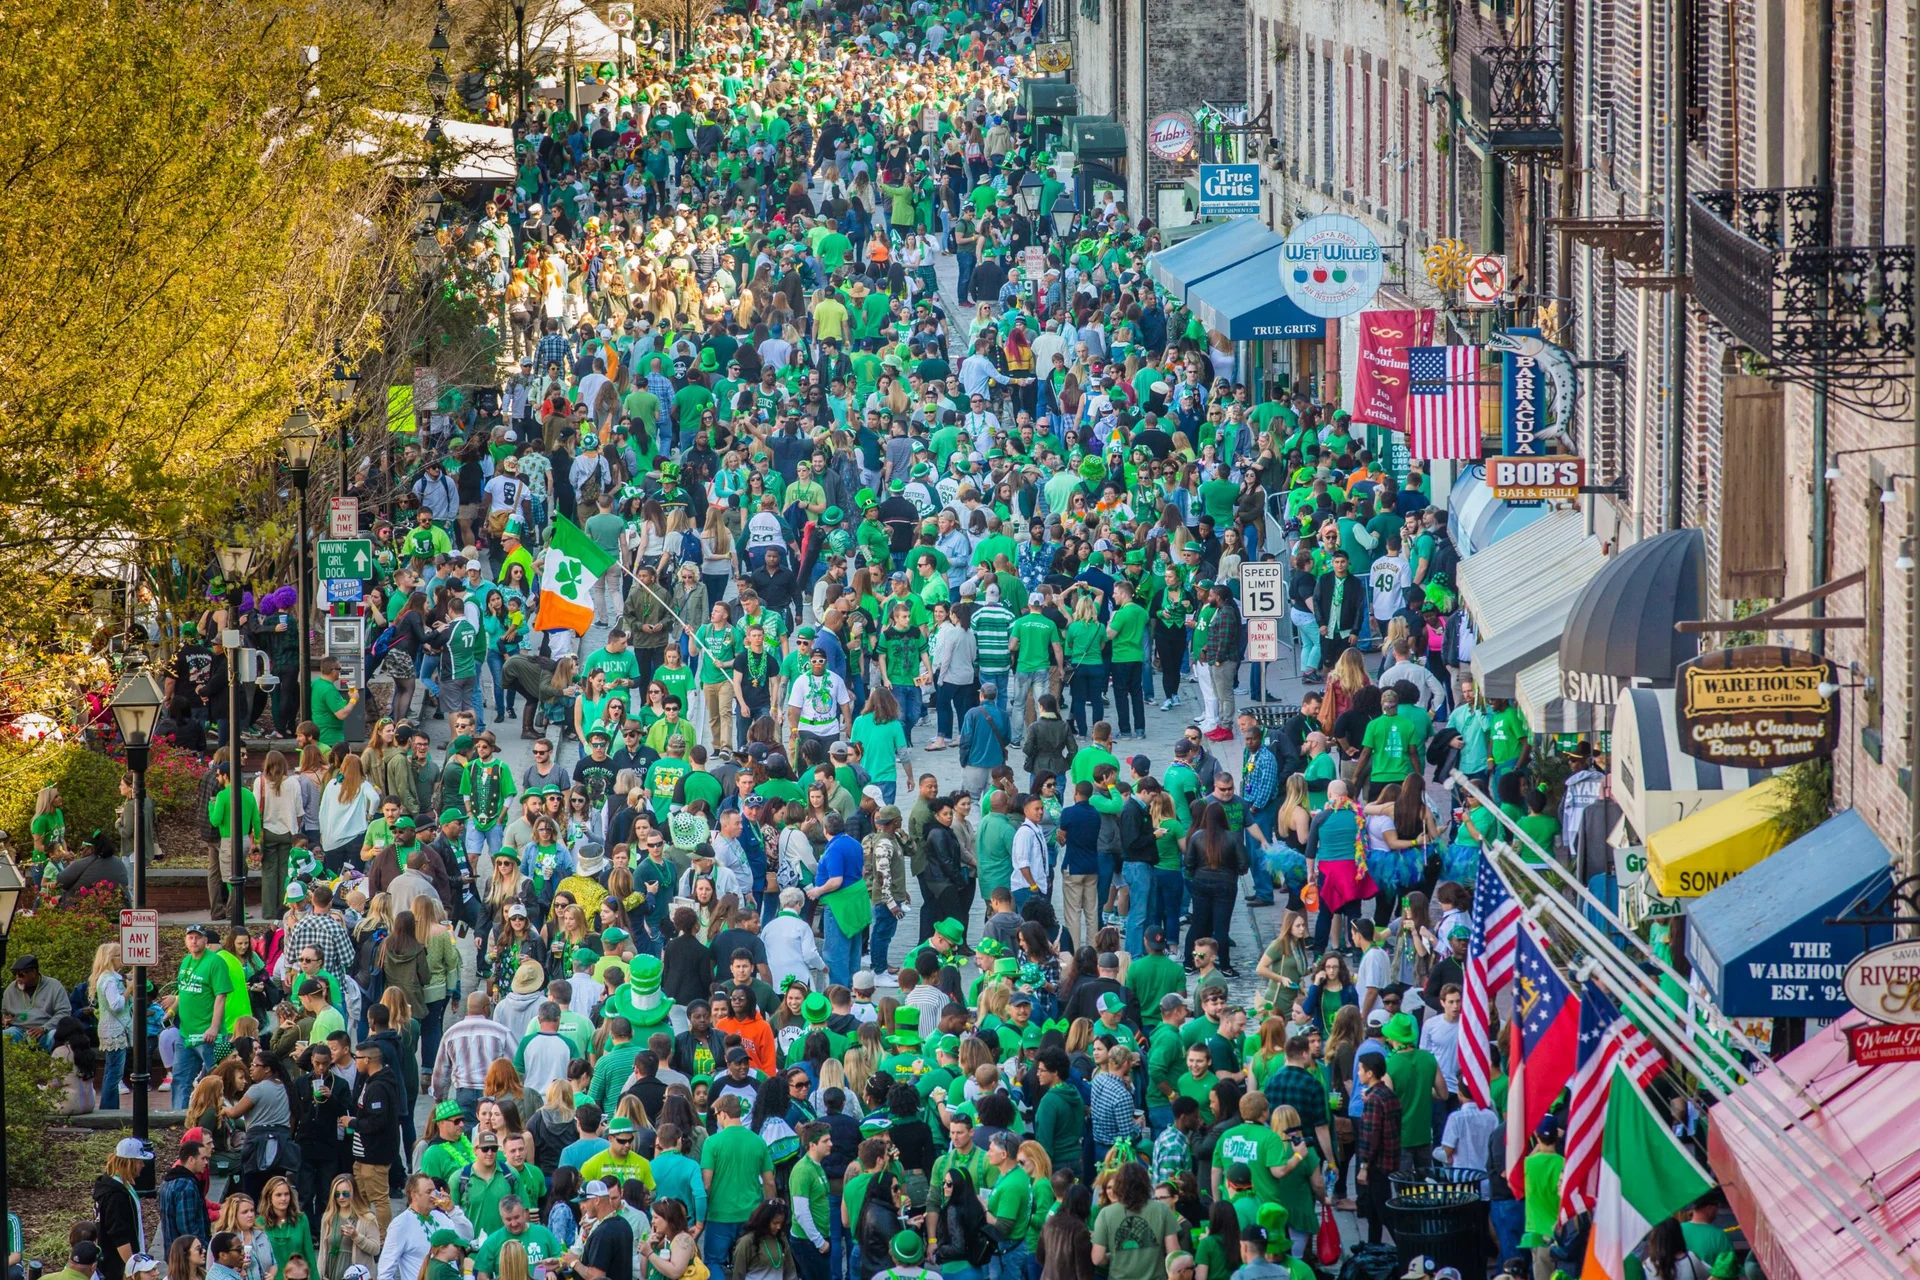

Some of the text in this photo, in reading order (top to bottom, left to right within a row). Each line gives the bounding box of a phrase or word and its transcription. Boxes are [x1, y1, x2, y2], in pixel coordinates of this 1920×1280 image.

[1216, 169, 1252, 184] True
[1205, 176, 1254, 197] Grits
[1311, 232, 1326, 243] BAR
[1337, 232, 1359, 247] PARTY
[1304, 286, 1357, 303] AN INSTITUTION
[1252, 324, 1317, 336] TRUE GRITS
[1376, 346, 1393, 357] Art
[1370, 397, 1393, 413] Local
[1515, 356, 1536, 454] BARRACUDA
[1496, 462, 1579, 486] BOB'S
[1498, 487, 1575, 497] BAR & GRILL
[320, 543, 347, 554] WAVING
[328, 556, 343, 566] GIRL
[1372, 562, 1399, 573] ANDERSON
[326, 568, 346, 578] DOCK
[1244, 569, 1279, 577] SPEED
[1248, 580, 1275, 589] LIMIT
[1375, 573, 1393, 592] 49
[1249, 592, 1275, 612] 15
[1257, 623, 1268, 631] NO
[461, 635, 474, 648] 17
[1250, 633, 1275, 642] PARKING
[1568, 669, 1653, 705] SMIL
[1704, 675, 1819, 694] WAREHOUSE
[1716, 692, 1801, 704] Bar & Grille
[1755, 720, 1827, 739] Cheapest
[1707, 738, 1815, 756] Beer In Town
[122, 913, 156, 925] NO PARKING
[129, 933, 150, 944] ANY
[127, 947, 151, 958] TIME
[1789, 942, 1831, 958] THE
[1771, 985, 1814, 1001] EST.
[1856, 1029, 1902, 1051] World
[1861, 1050, 1879, 1060] SALT
[1880, 1047, 1905, 1058] WATER
